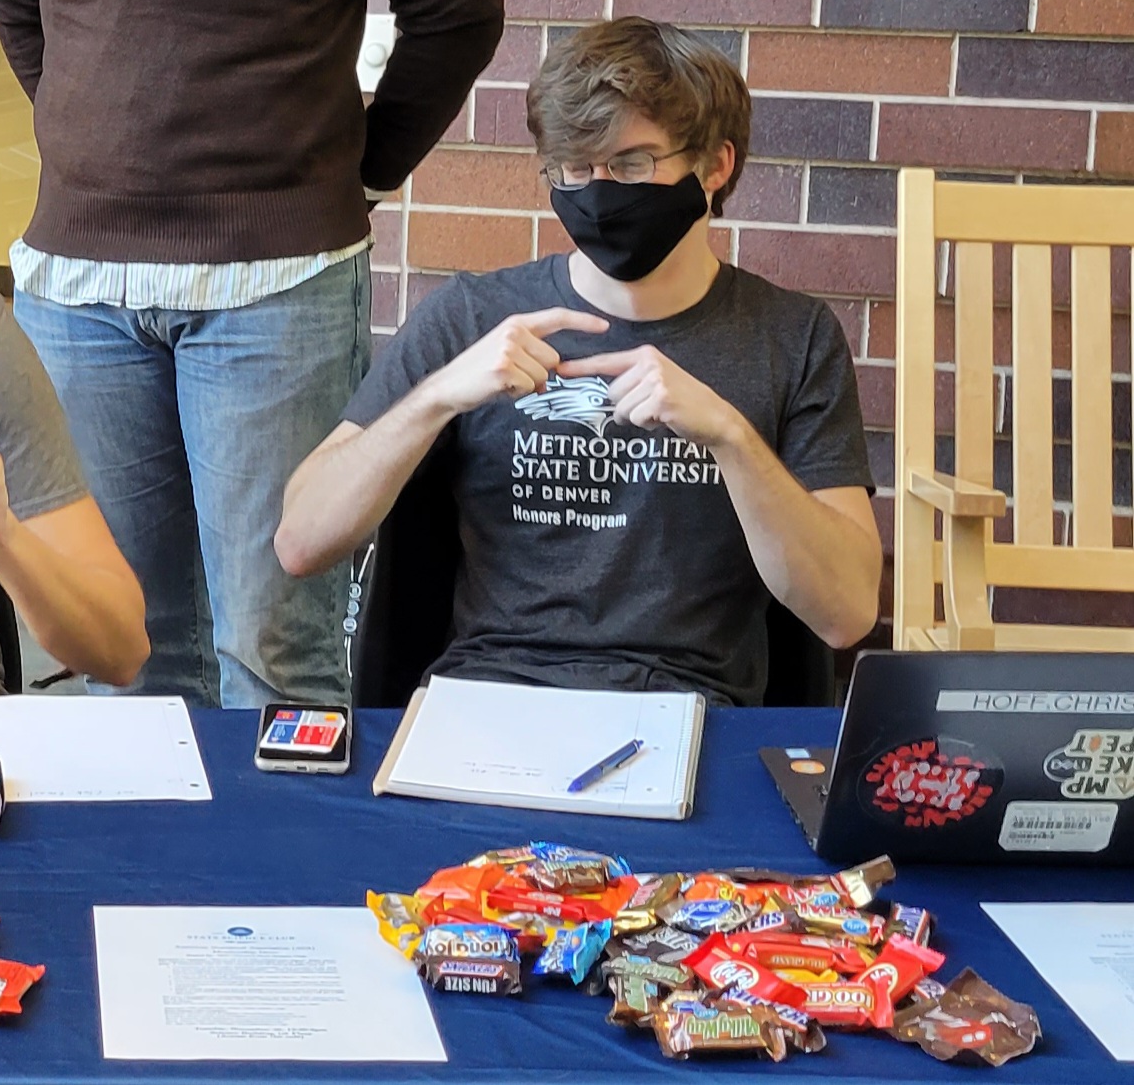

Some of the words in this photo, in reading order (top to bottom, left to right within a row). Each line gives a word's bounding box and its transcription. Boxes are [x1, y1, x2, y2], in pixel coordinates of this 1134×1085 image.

[511, 455, 580, 481] STATE
[589, 458, 722, 485] UNIVERSIT
[512, 484, 534, 498] OF
[542, 487, 612, 505] DENVER
[513, 504, 561, 526] Honors
[566, 509, 627, 532] Program
[445, 976, 471, 993] SIZE
[472, 976, 498, 994] FUN
